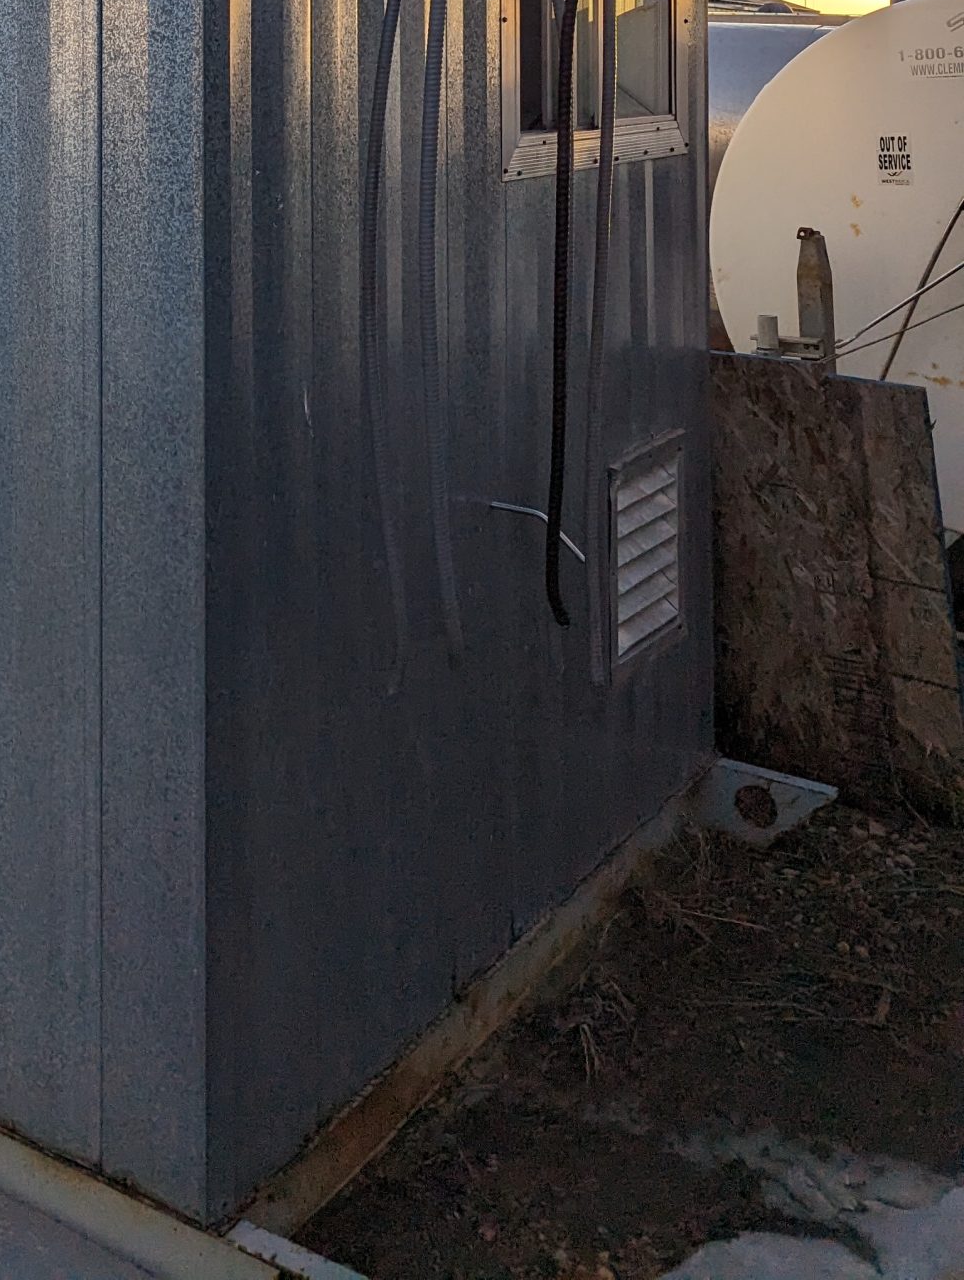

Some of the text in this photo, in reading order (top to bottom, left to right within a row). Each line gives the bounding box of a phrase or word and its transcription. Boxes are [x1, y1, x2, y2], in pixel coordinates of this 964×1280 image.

[898, 46, 964, 62] 1-800-6
[879, 136, 907, 152] OUT OF
[878, 154, 912, 170] SERVICE
